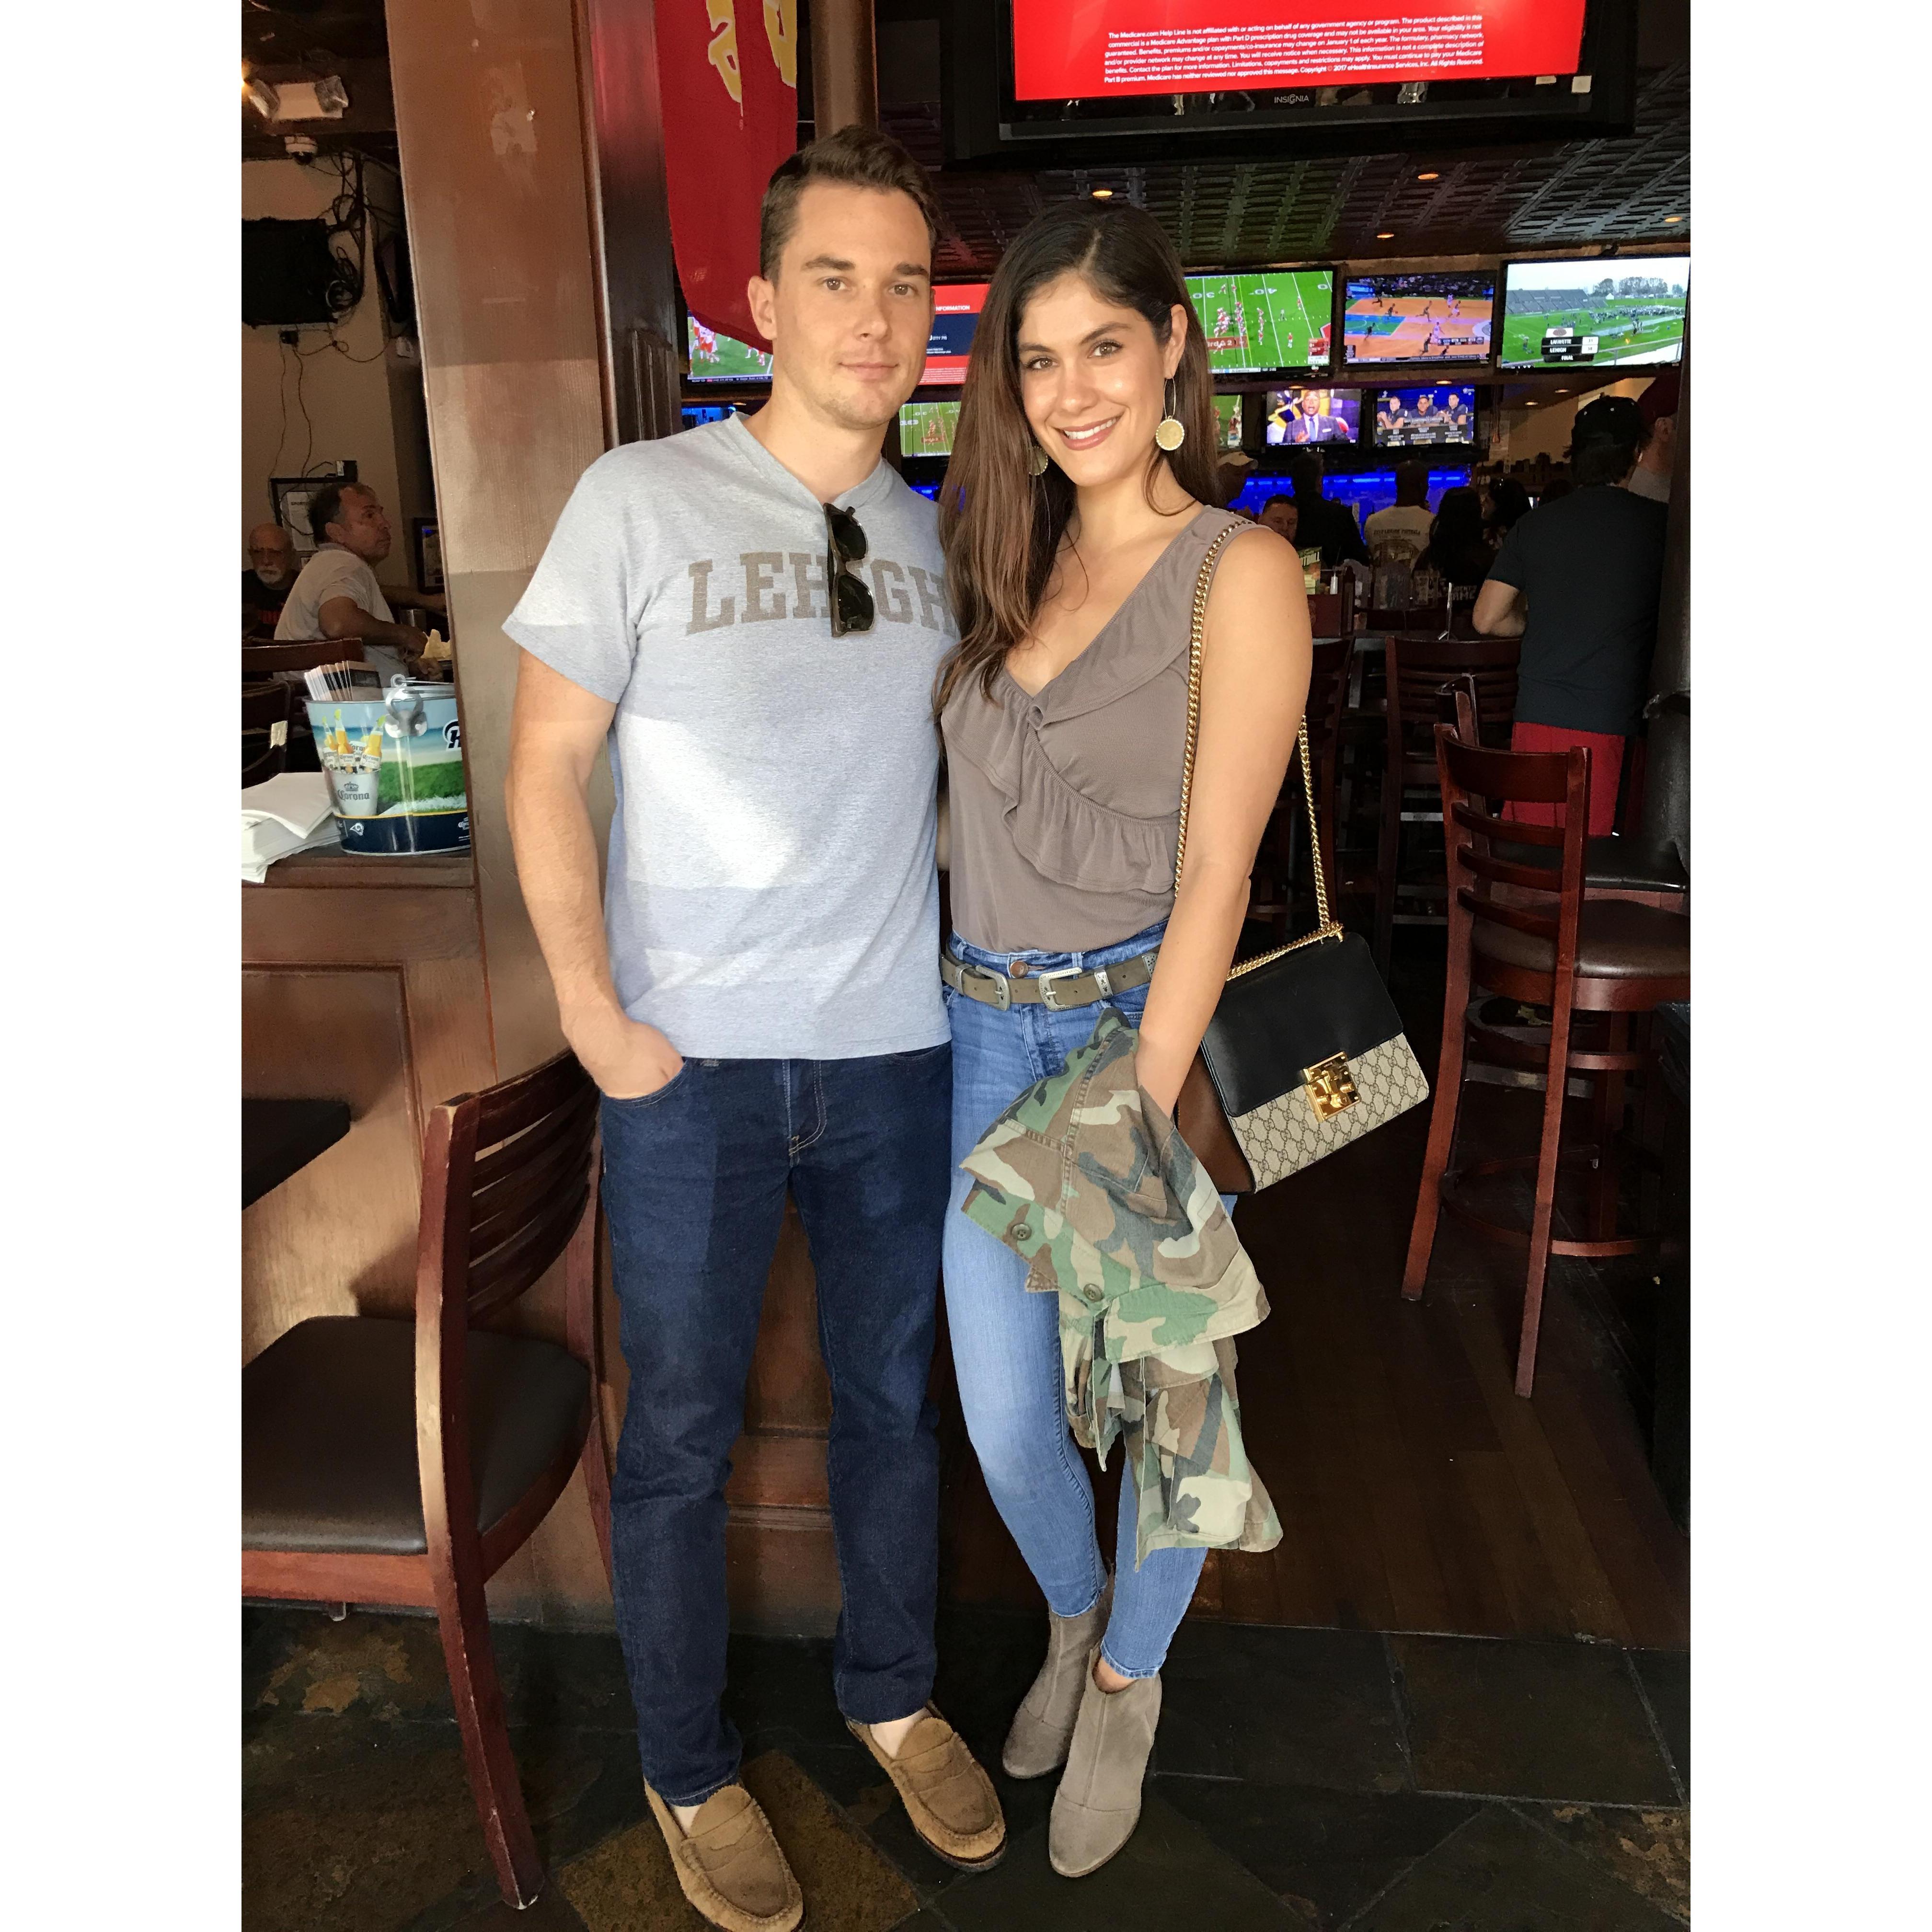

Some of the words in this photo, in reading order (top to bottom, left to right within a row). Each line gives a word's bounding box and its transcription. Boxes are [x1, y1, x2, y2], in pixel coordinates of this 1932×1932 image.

[1311, 22, 1346, 30] government
[1250, 34, 1283, 42] prescription
[1441, 24, 1466, 32] eligibility
[1105, 49, 1138, 58] guaranteed.
[1124, 58, 1146, 66] provider
[1274, 94, 1309, 104] INSIGNIA
[685, 551, 958, 638] LEHGH
[337, 790, 370, 801] Corona
